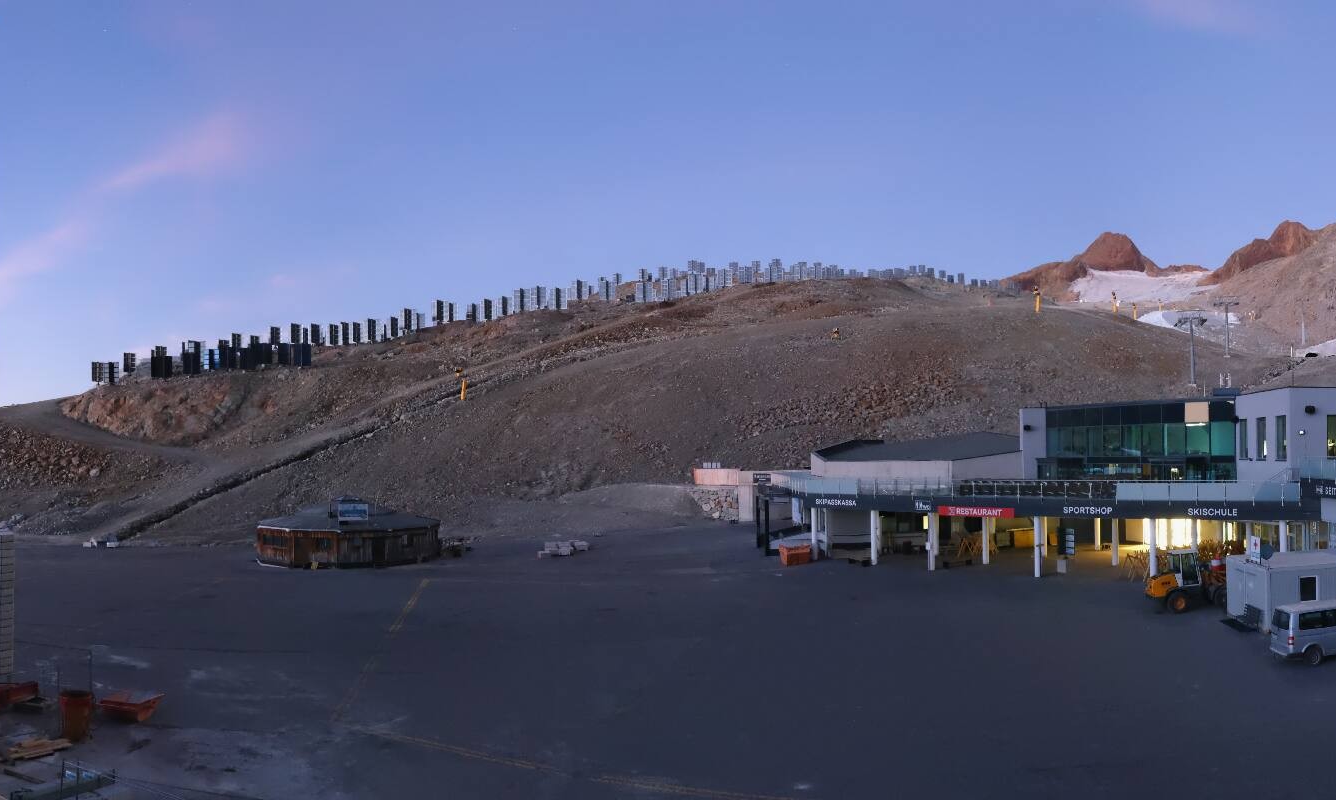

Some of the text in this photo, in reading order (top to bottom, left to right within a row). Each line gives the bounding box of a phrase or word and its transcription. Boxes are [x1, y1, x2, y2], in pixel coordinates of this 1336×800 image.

[815, 498, 857, 507] SKIPASSKASSA
[956, 507, 1002, 517] RESTAURANT
[1063, 506, 1113, 515] SPORTSHOP
[1187, 508, 1238, 517] SKISCHULE
